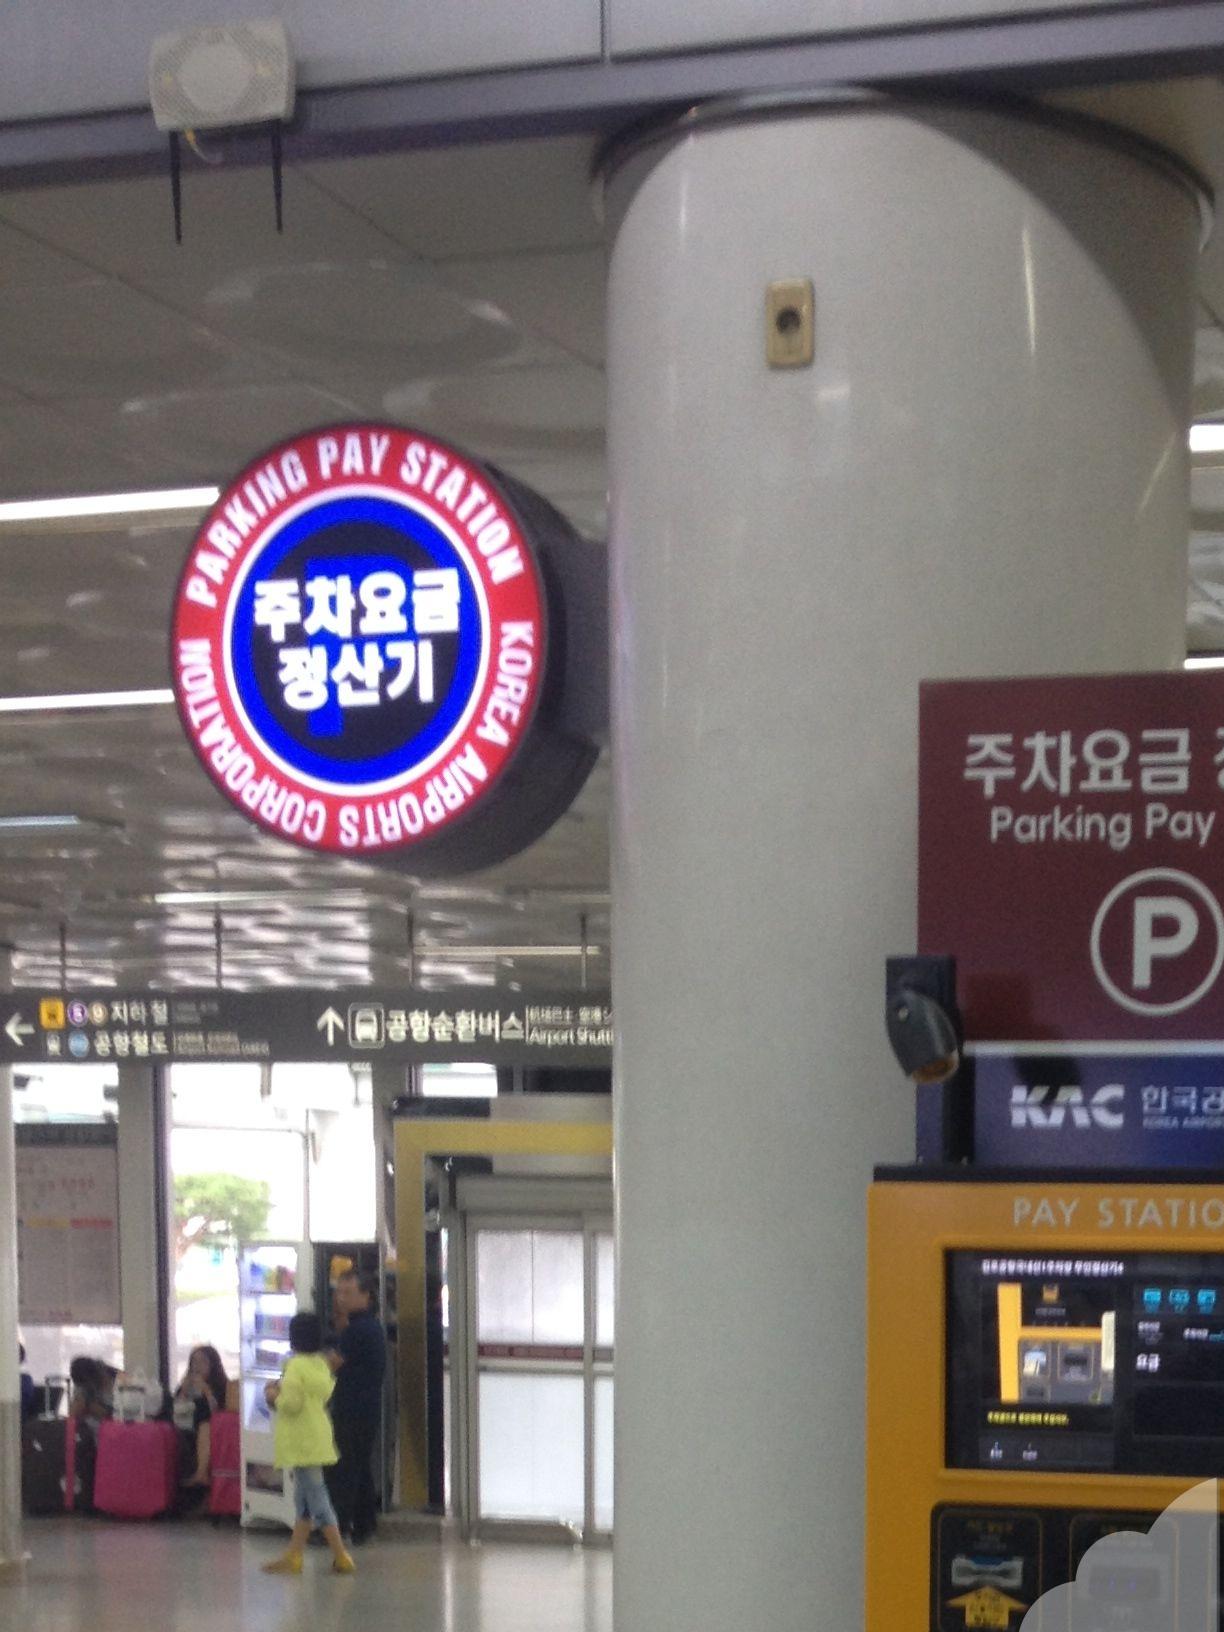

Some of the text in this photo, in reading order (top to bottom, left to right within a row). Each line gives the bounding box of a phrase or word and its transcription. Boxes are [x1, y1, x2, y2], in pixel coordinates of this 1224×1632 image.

[186, 433, 525, 608] PARKING PAY STATION
[253, 567, 461, 642] 주차요금
[278, 639, 435, 711] 정산기
[179, 621, 534, 847] KOREA AIRPORTS CORPORATION
[963, 728, 1192, 799] 주차요금
[990, 804, 1132, 850] Parking
[1145, 802, 1216, 846] Pay
[1132, 896, 1199, 990] P
[1010, 1084, 1125, 1129] KAC
[1011, 1197, 1081, 1228] PAY
